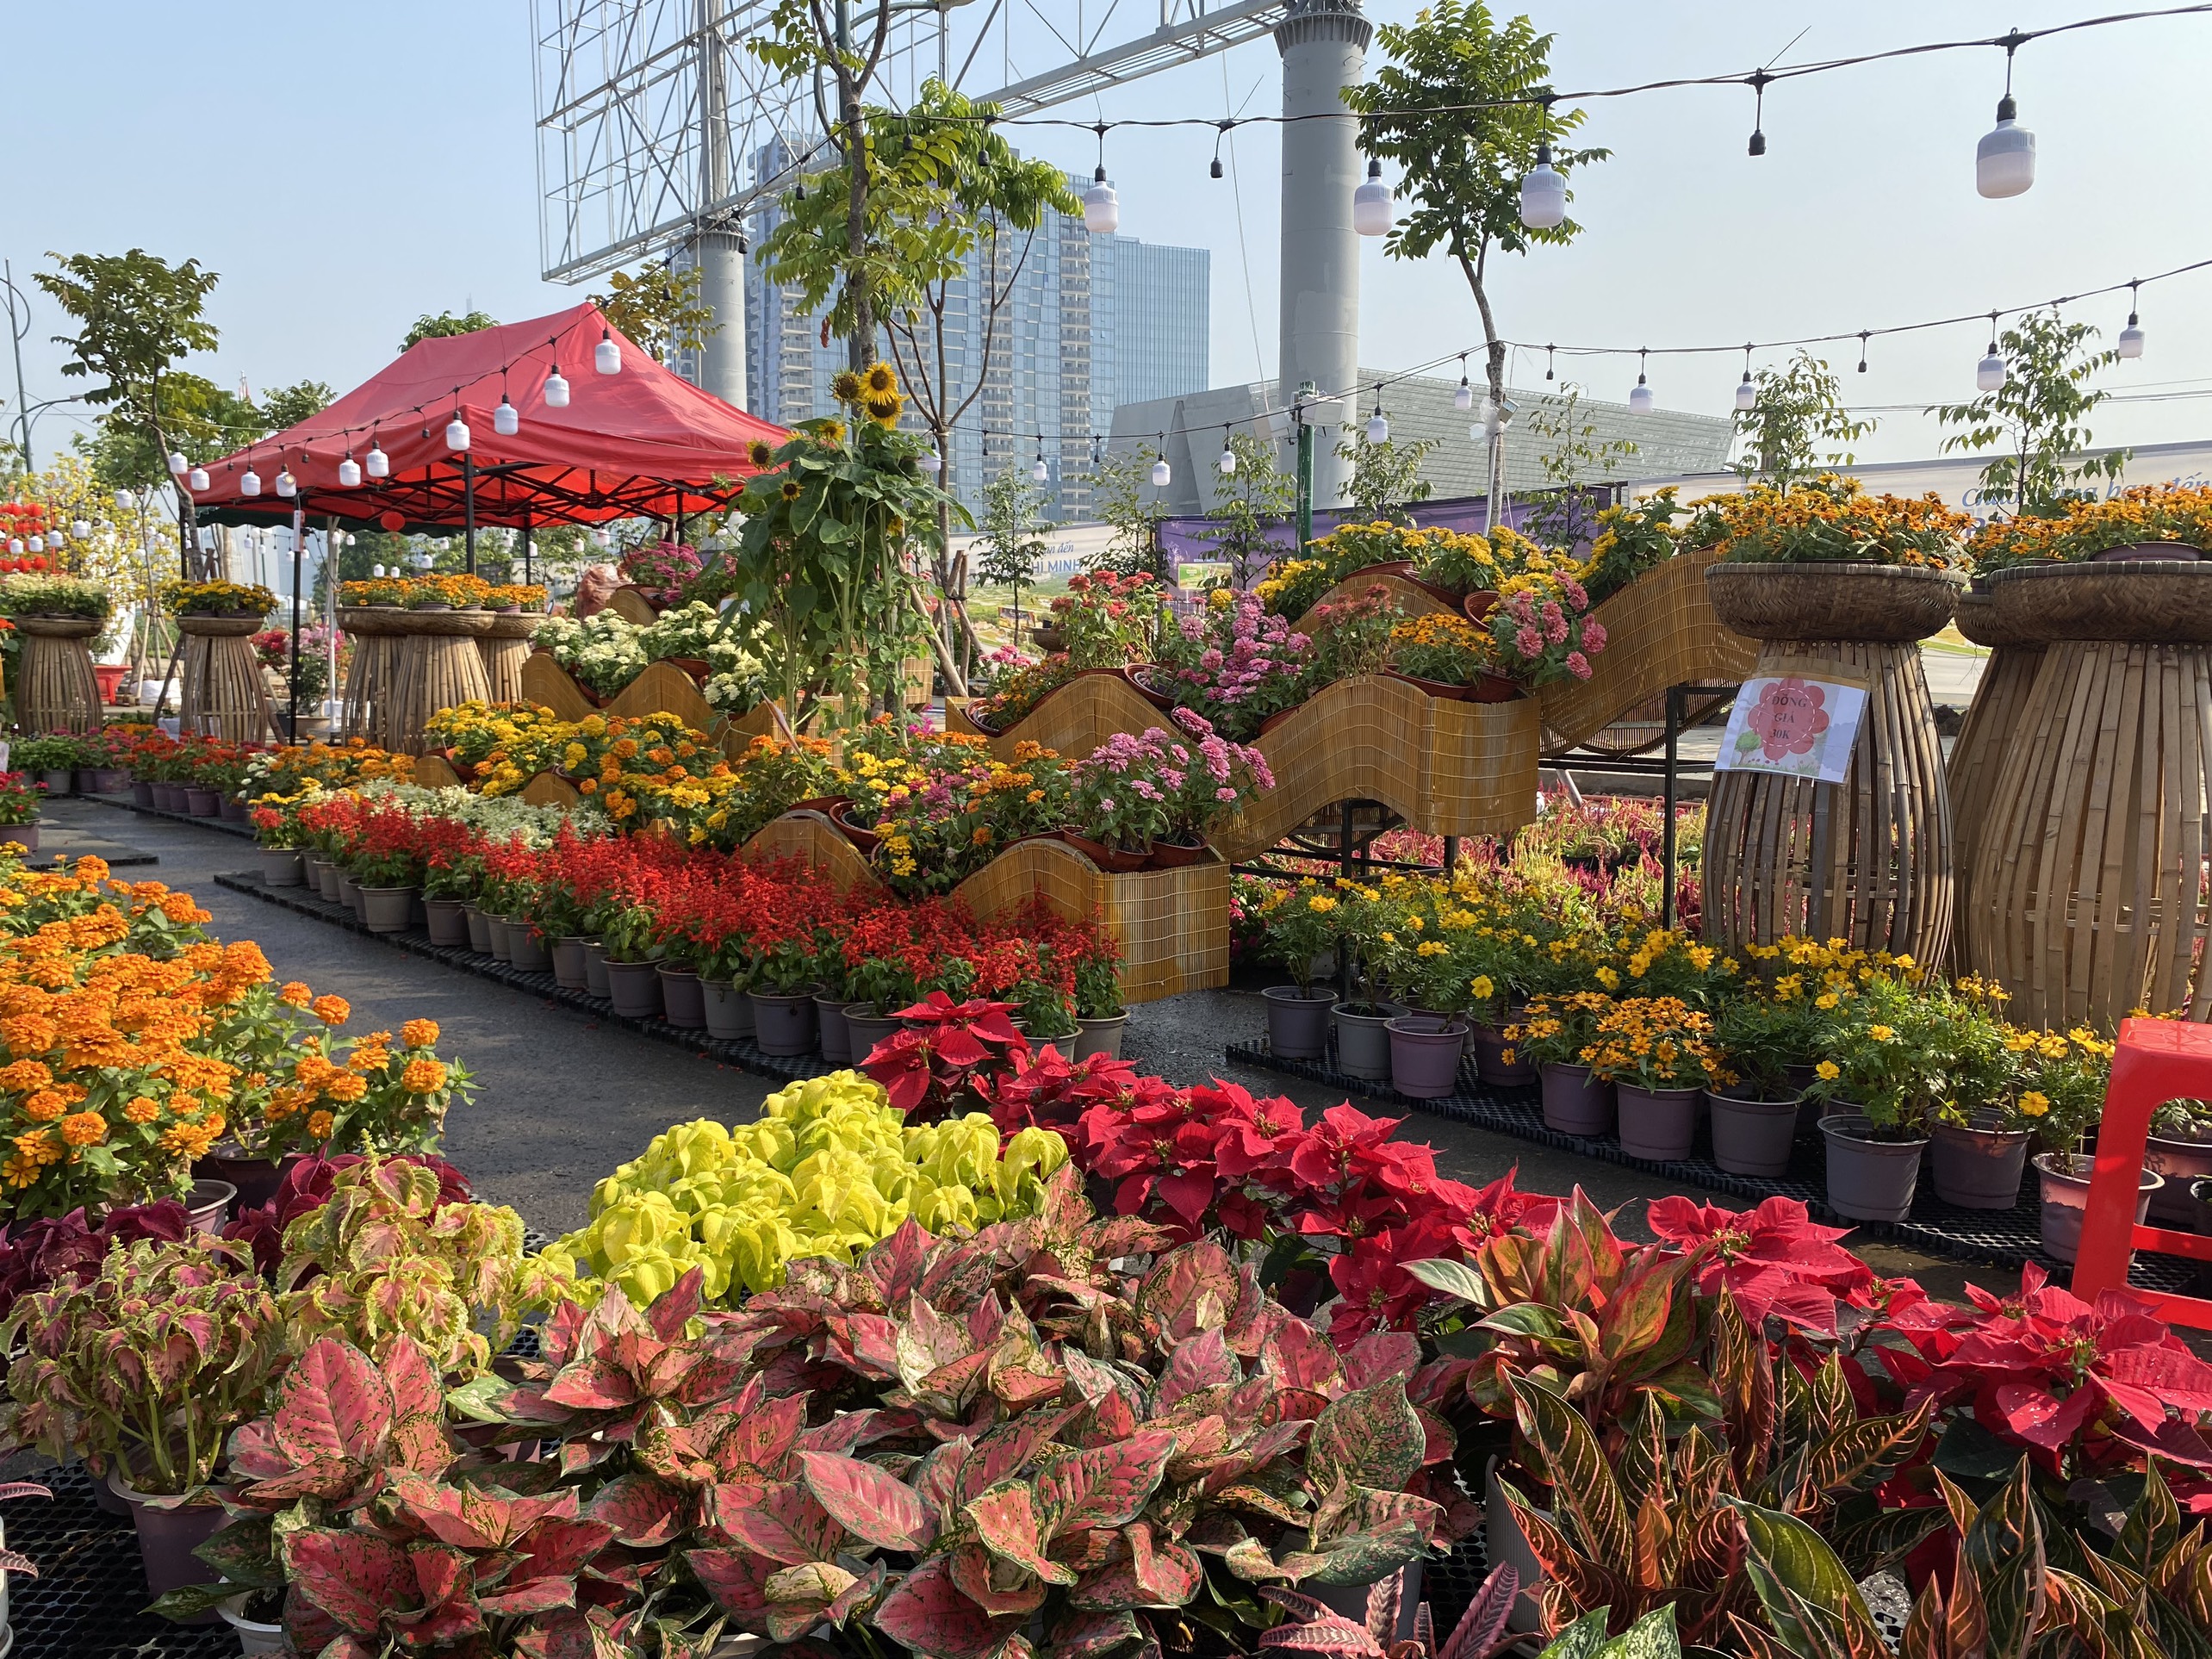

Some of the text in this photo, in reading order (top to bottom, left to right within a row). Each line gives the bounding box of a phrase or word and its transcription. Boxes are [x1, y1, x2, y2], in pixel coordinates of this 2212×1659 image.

[1057, 539, 1074, 554] đến
[1047, 558, 1083, 574] MINH
[1769, 729, 1790, 740] 30K
